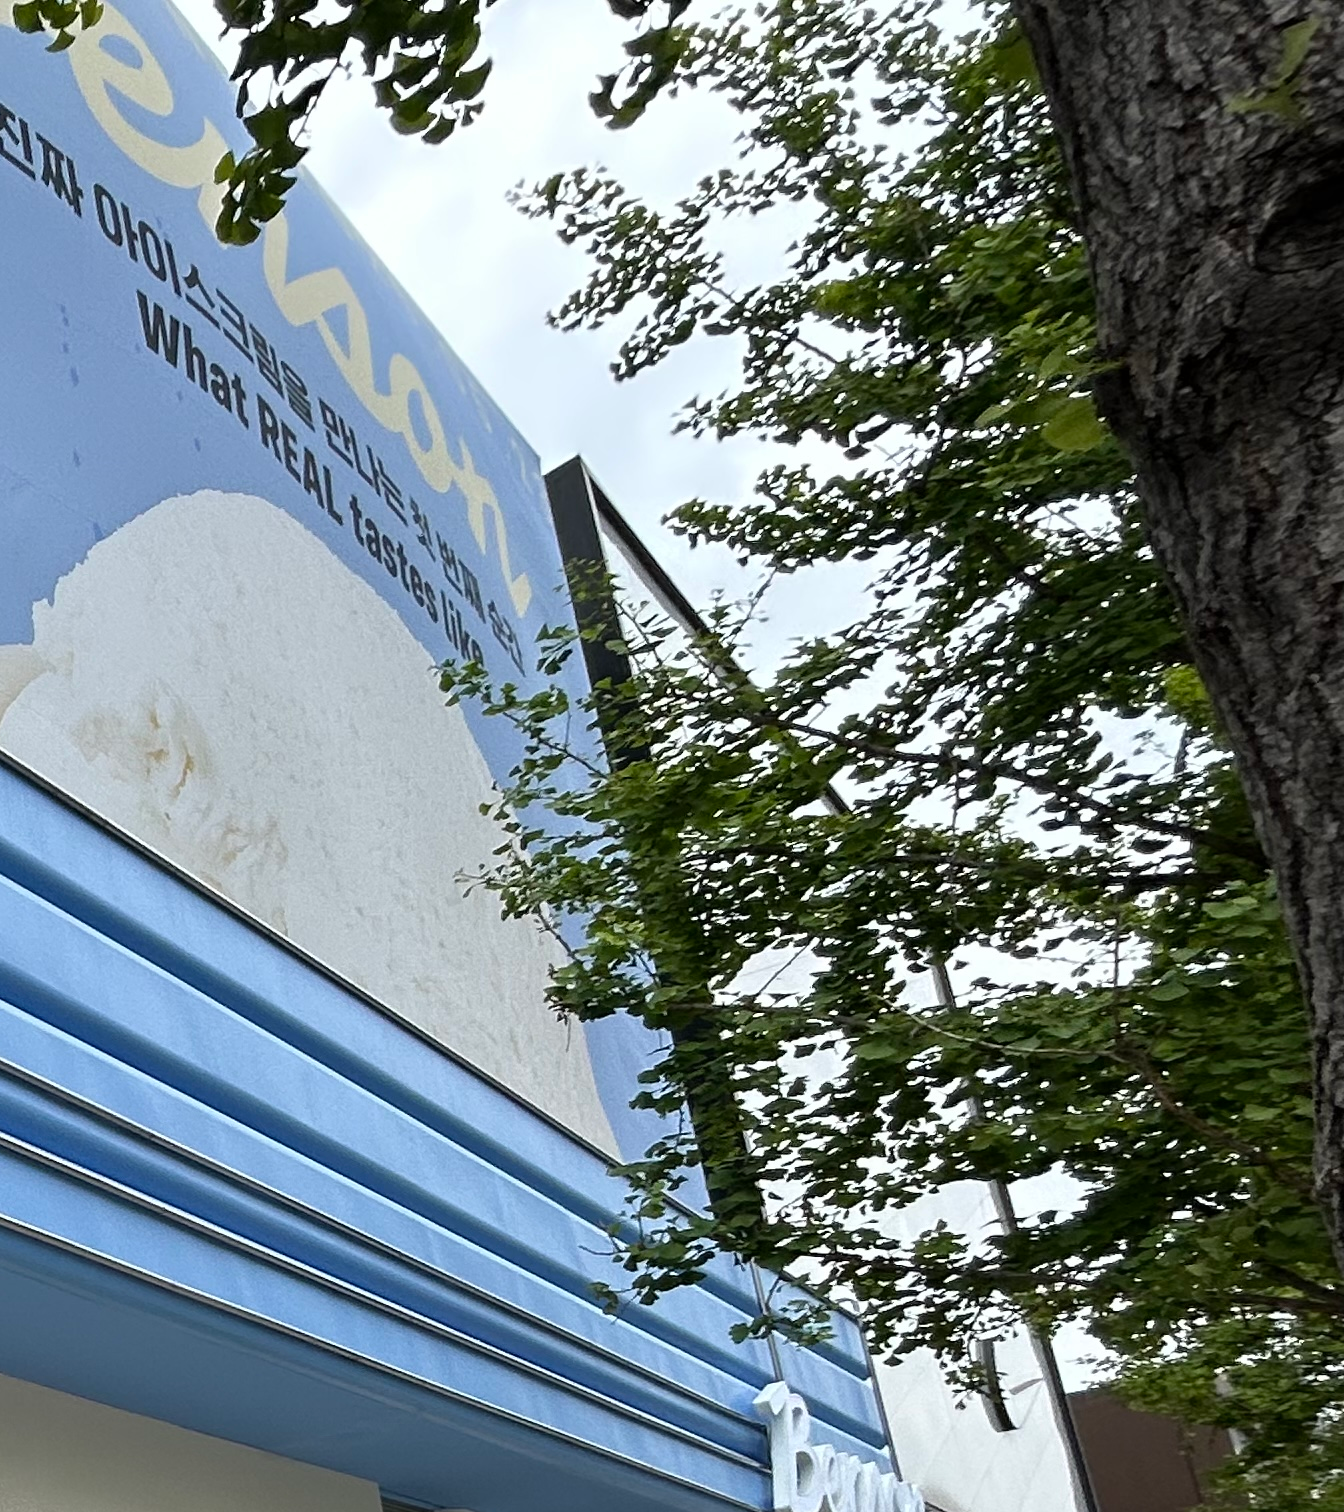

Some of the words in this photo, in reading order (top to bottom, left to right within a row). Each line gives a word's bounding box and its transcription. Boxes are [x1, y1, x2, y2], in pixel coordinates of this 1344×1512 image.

[94, 182, 315, 432] 아이스크림을
[319, 398, 408, 526] 만나는
[410, 497, 436, 564] 첫
[436, 527, 486, 625] 번째
[487, 599, 526, 677] 순간
[136, 289, 249, 429] What
[259, 392, 344, 528] REAL
[349, 495, 440, 625] tastes
